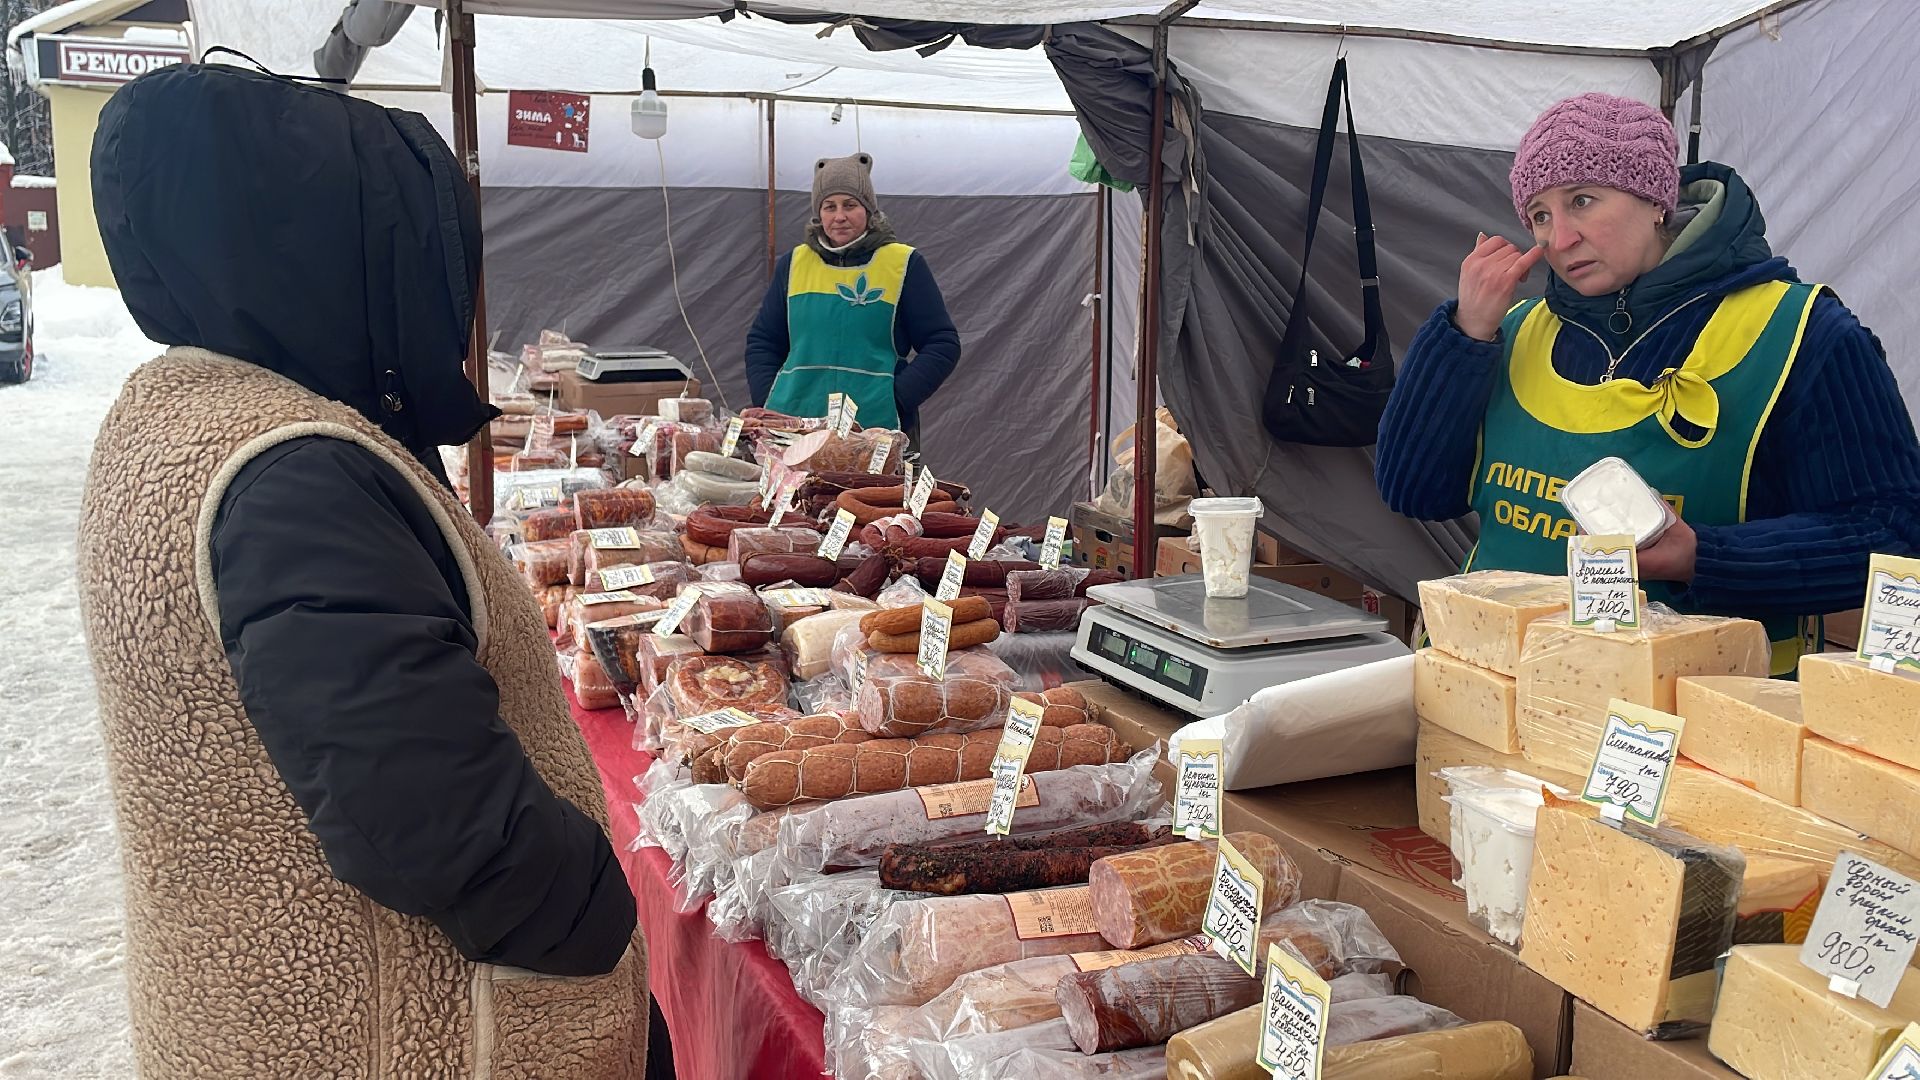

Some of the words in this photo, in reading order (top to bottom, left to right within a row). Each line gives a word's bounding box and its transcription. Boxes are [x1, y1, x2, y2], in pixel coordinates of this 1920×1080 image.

[515, 109, 553, 123] ЗИМА
[1495, 500, 1577, 540] ОБЛА
[1605, 775, 1642, 806] 790р
[1818, 931, 1875, 981] 980р
